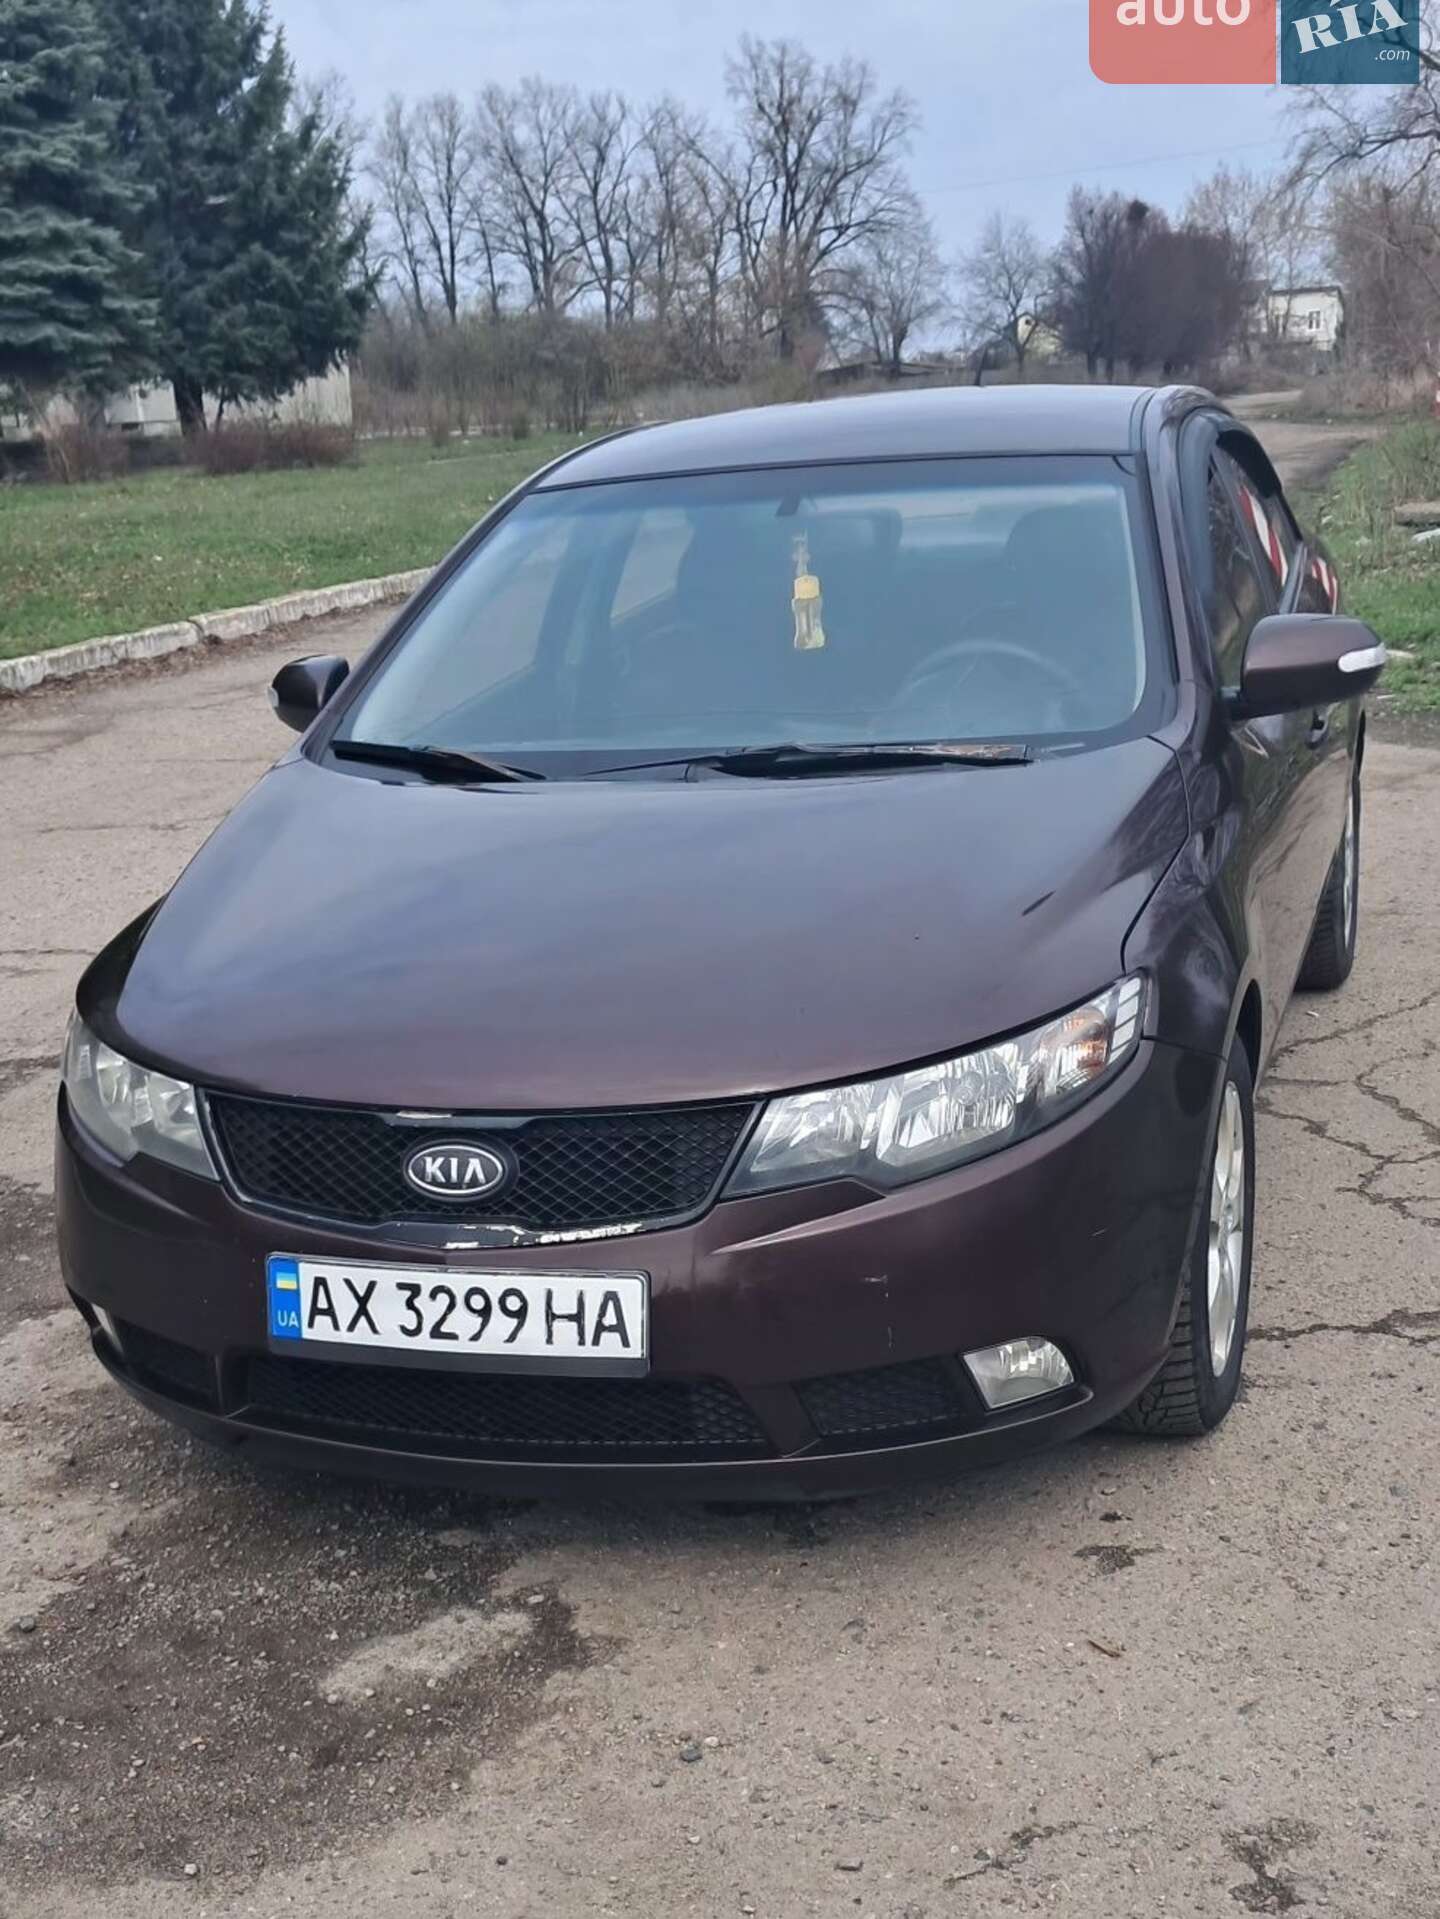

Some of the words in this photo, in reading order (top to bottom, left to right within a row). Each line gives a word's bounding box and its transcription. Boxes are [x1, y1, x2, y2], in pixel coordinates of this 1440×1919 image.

[423, 1155, 487, 1184] KIA
[278, 1309, 299, 1328] UA
[307, 1276, 381, 1336] AX
[395, 1281, 529, 1344] 3299
[544, 1287, 632, 1348] HA
